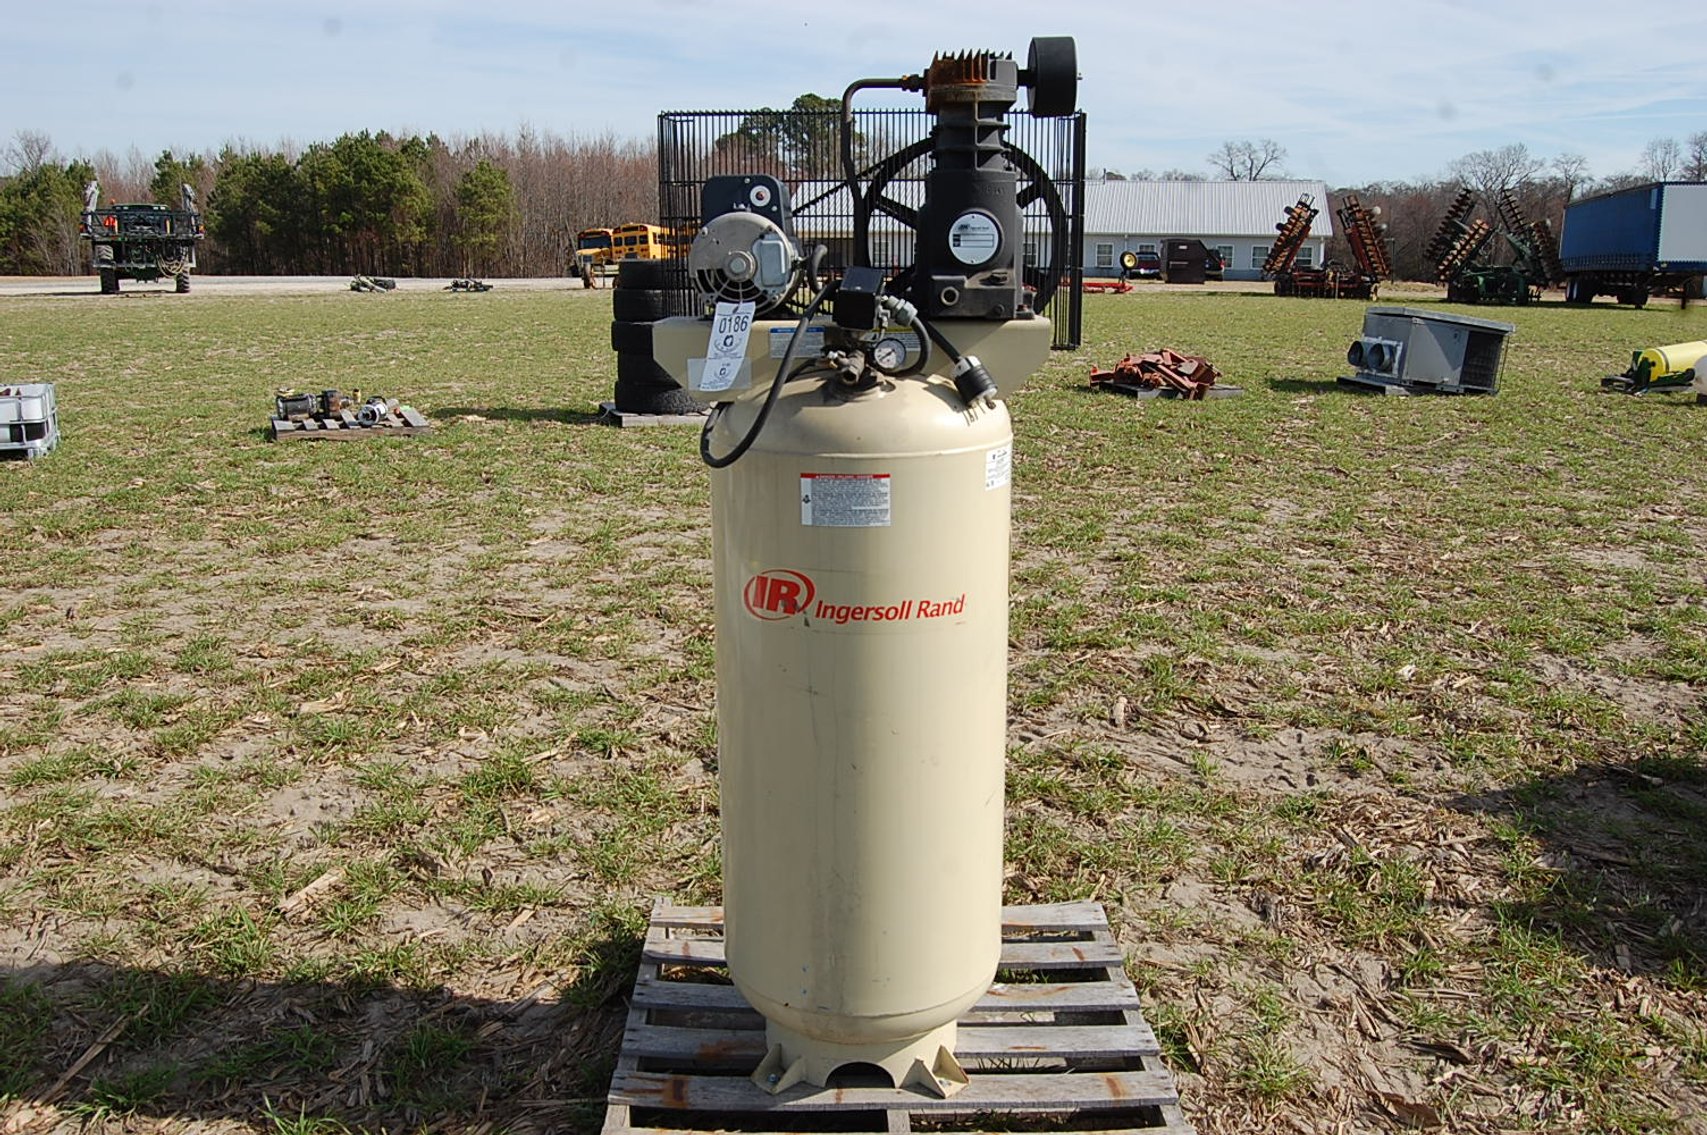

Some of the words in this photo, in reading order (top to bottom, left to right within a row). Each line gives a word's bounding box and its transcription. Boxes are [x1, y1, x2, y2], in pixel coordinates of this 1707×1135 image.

[719, 315, 749, 334] 0186
[752, 574, 802, 616] IR
[815, 600, 911, 625] Ingersoll
[917, 594, 965, 619] Rand
